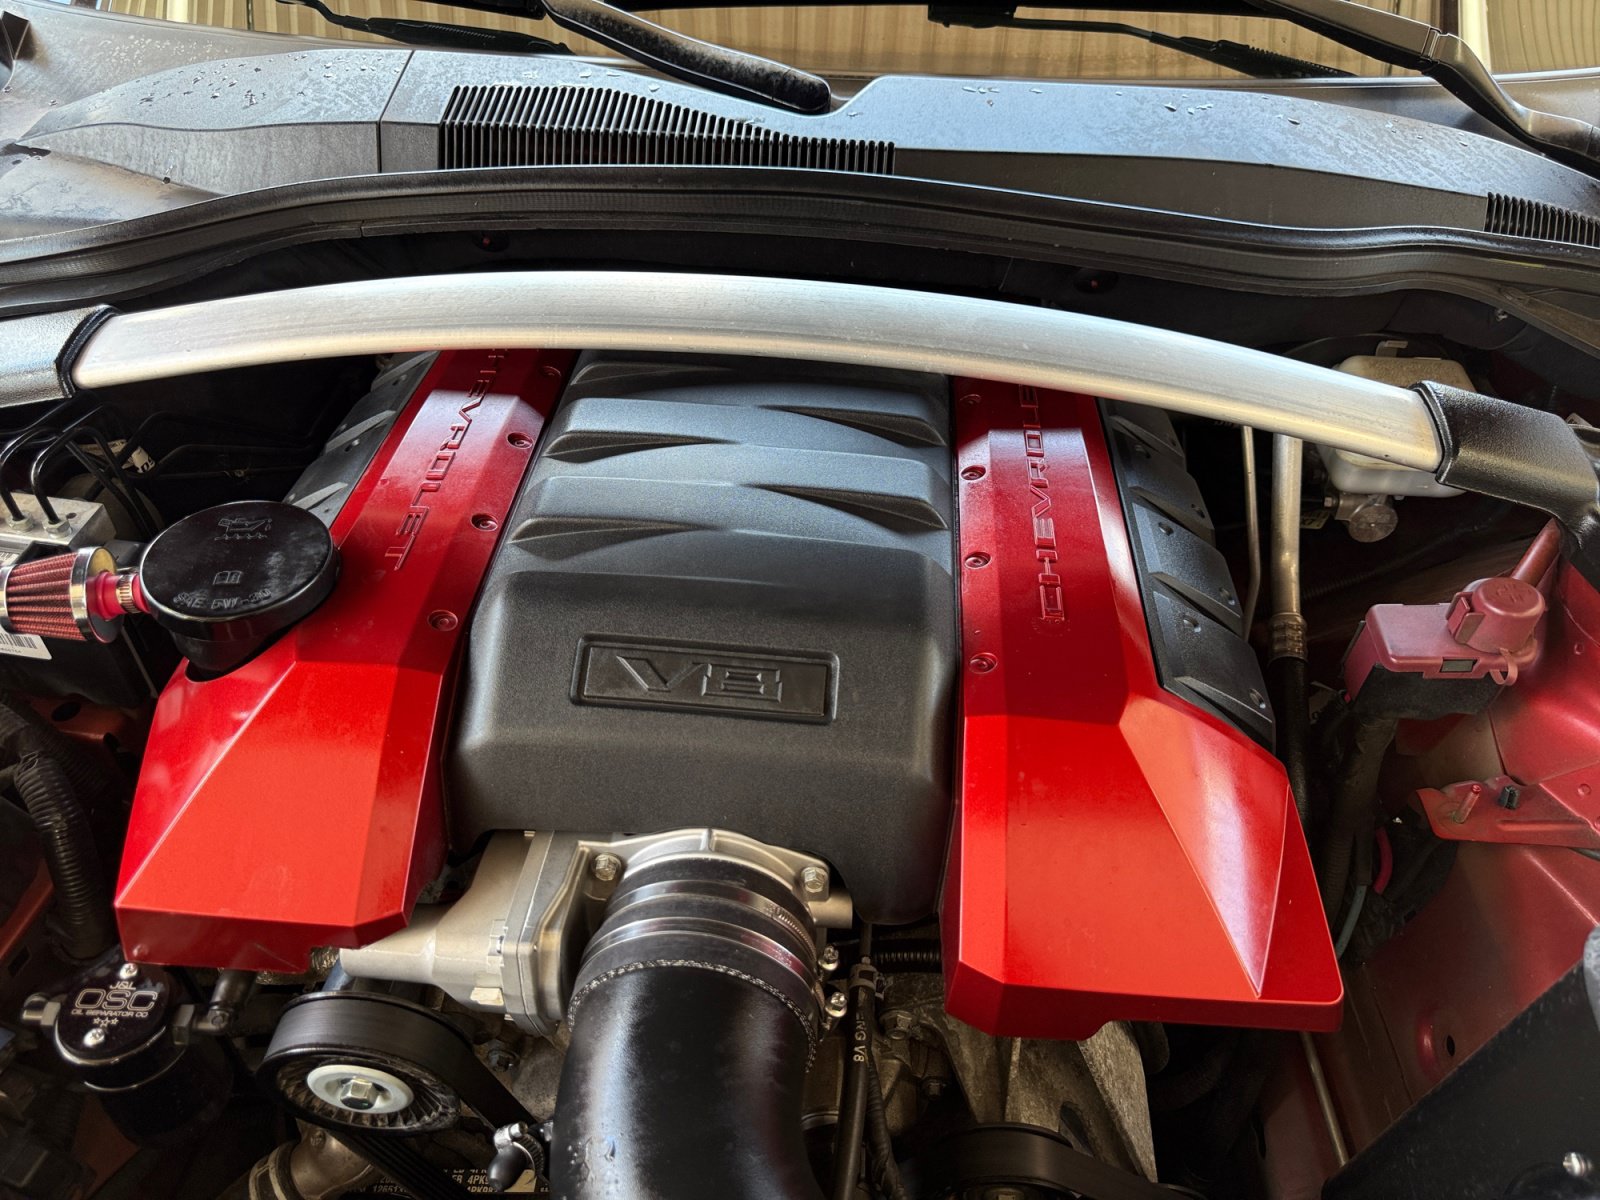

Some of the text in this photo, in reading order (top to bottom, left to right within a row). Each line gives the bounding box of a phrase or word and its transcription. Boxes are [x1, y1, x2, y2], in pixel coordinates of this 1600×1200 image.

[385, 349, 507, 571] HEVROLET
[1019, 383, 1065, 620] CHEVROLE
[616, 655, 782, 703] V8
[109, 981, 136, 990] J&L
[75, 989, 158, 1011] OSC
[85, 1009, 134, 1017] SEPARATOR
[853, 1046, 865, 1062] V8
